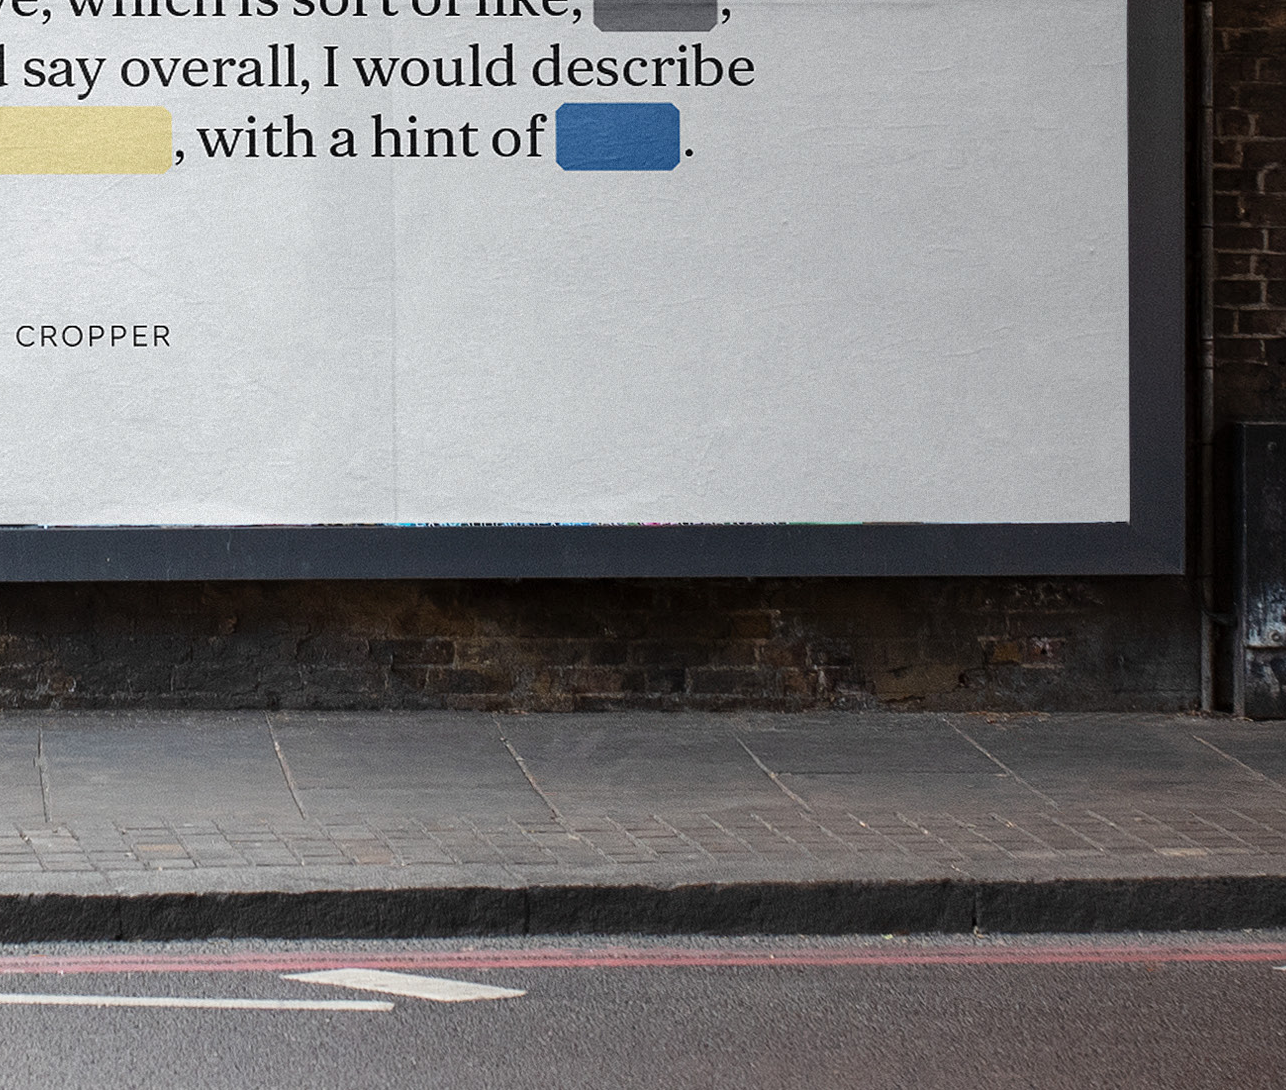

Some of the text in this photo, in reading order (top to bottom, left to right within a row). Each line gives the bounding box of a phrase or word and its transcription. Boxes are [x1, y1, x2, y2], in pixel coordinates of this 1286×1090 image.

[26, 60, 106, 101] say
[123, 45, 310, 95] overall,
[326, 48, 338, 87] I
[354, 45, 516, 87] would
[534, 44, 755, 87] describe
[198, 115, 317, 158] with
[331, 130, 357, 158] a
[373, 115, 479, 158] hint
[494, 115, 548, 158] of
[18, 327, 170, 348] CROPPER
